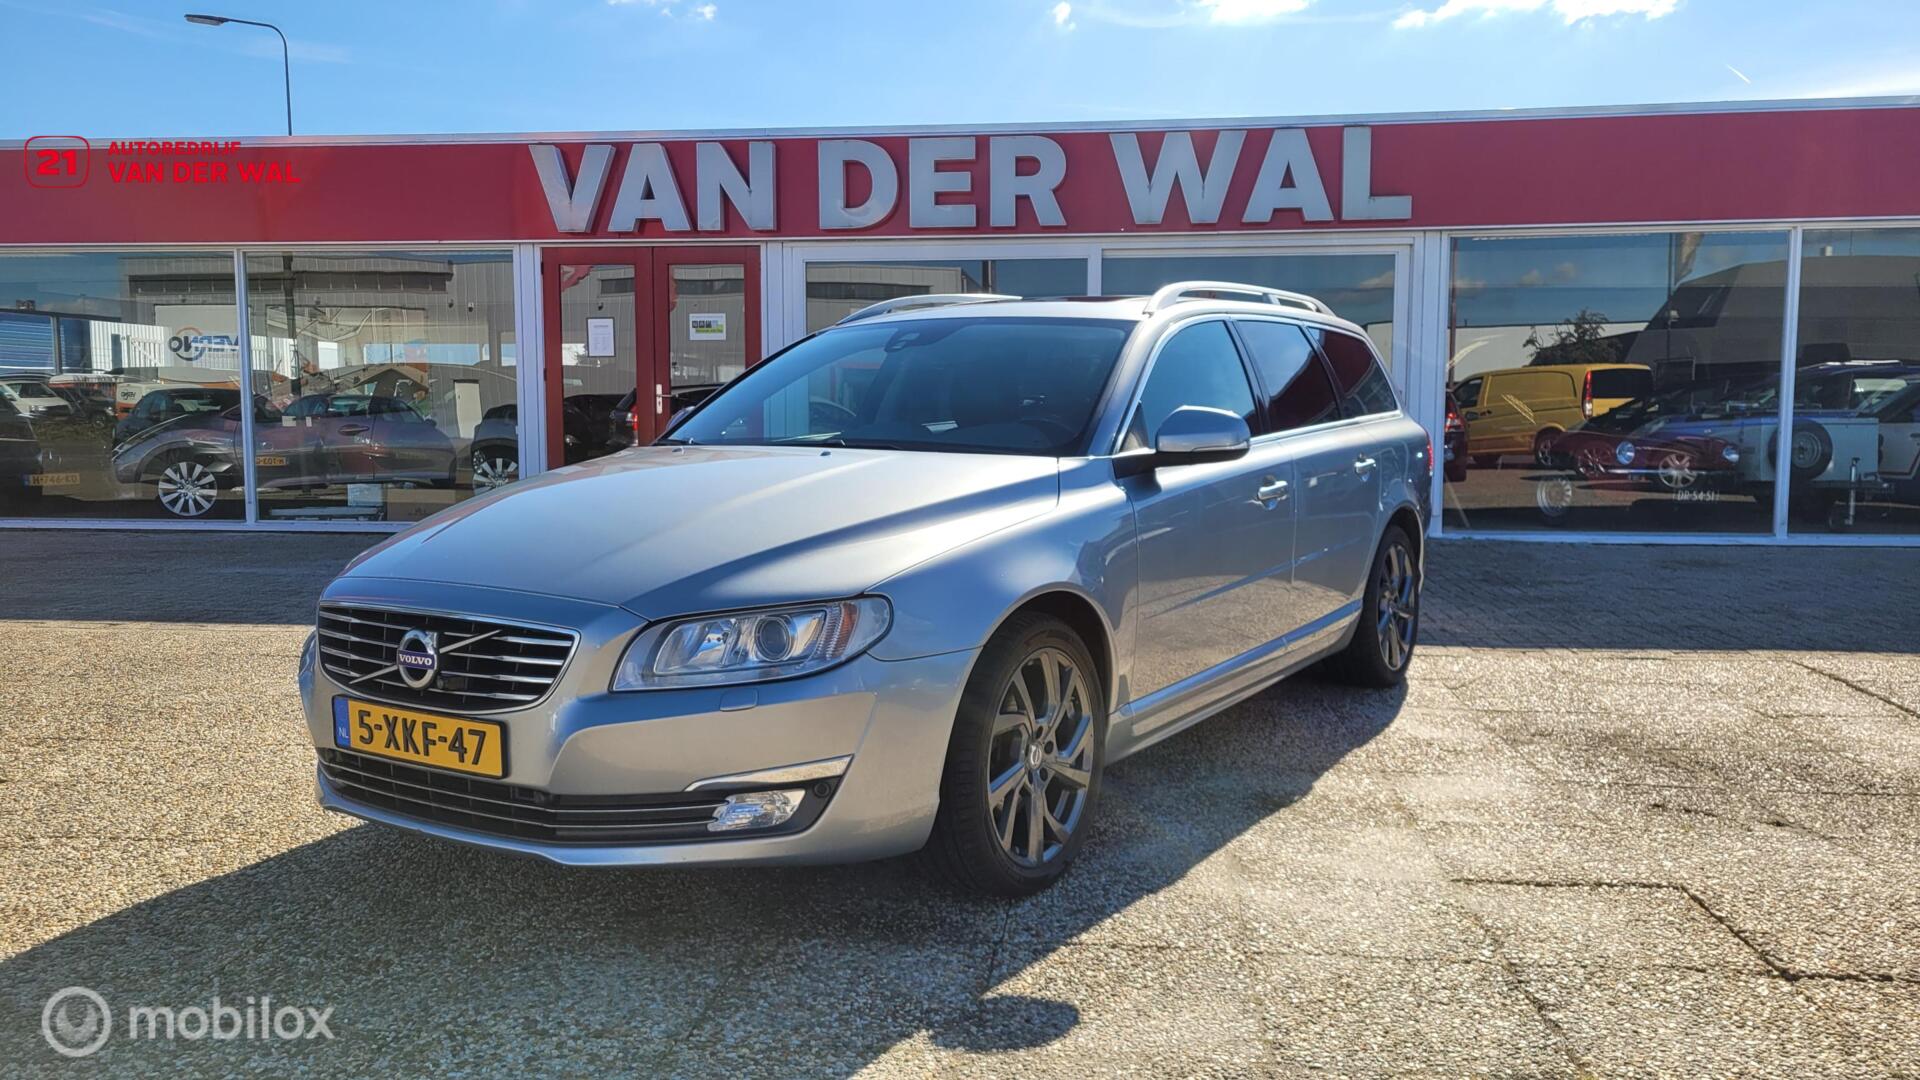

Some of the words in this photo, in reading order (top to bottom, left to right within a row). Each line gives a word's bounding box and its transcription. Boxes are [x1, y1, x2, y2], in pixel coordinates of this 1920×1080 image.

[528, 140, 776, 234] VAN
[818, 135, 1067, 230] DER
[1109, 126, 1413, 226] WAL
[398, 653, 432, 666] VOLVO
[338, 727, 349, 738] NL
[357, 709, 487, 766] 5-XKF-47
